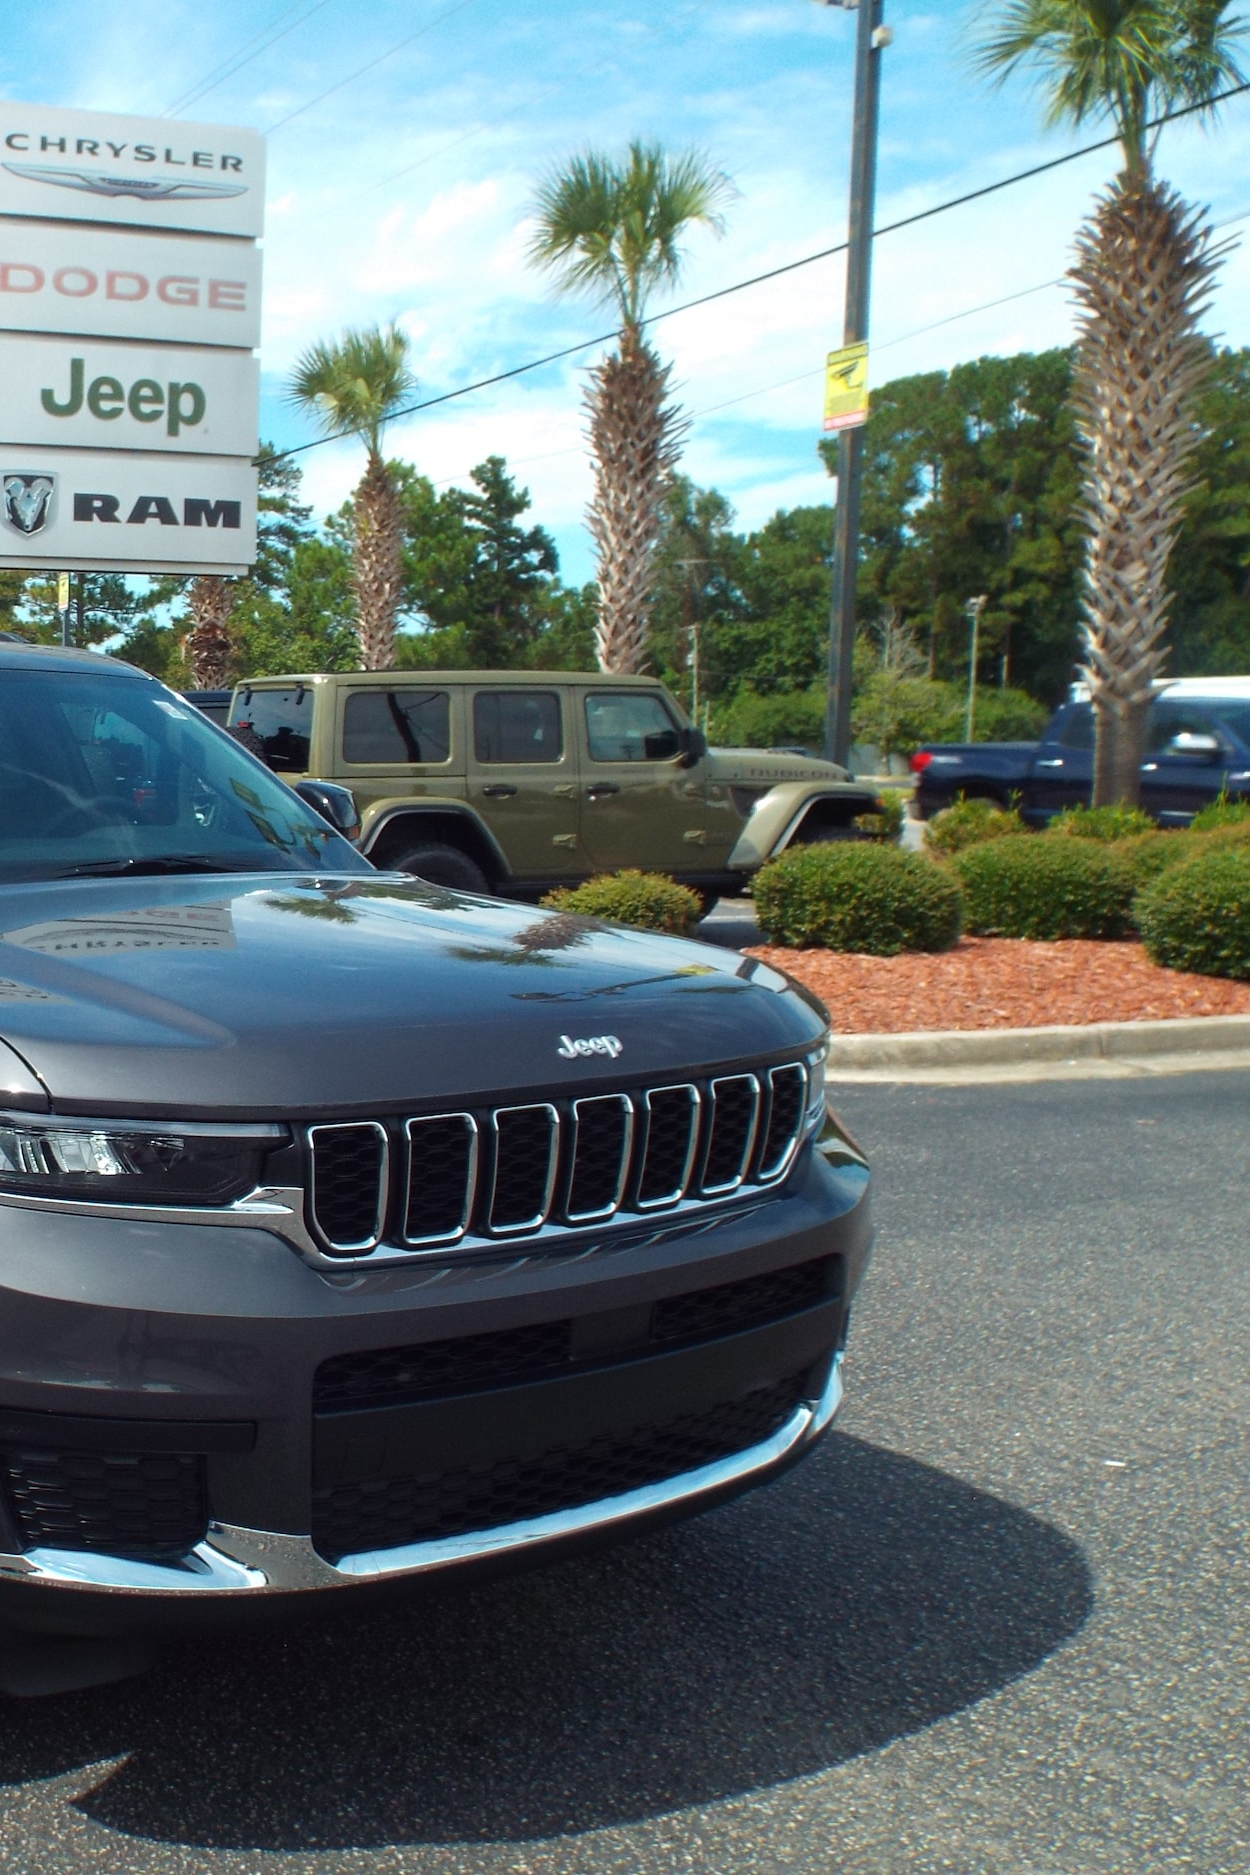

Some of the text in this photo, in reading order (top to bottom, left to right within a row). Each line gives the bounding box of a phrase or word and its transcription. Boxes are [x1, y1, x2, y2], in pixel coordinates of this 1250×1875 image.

[5, 132, 244, 172] CHRYSLER
[40, 357, 207, 437] Jeep
[72, 492, 242, 530] RAM
[751, 768, 838, 780] RUBICON
[557, 1034, 623, 1059] Jeep
